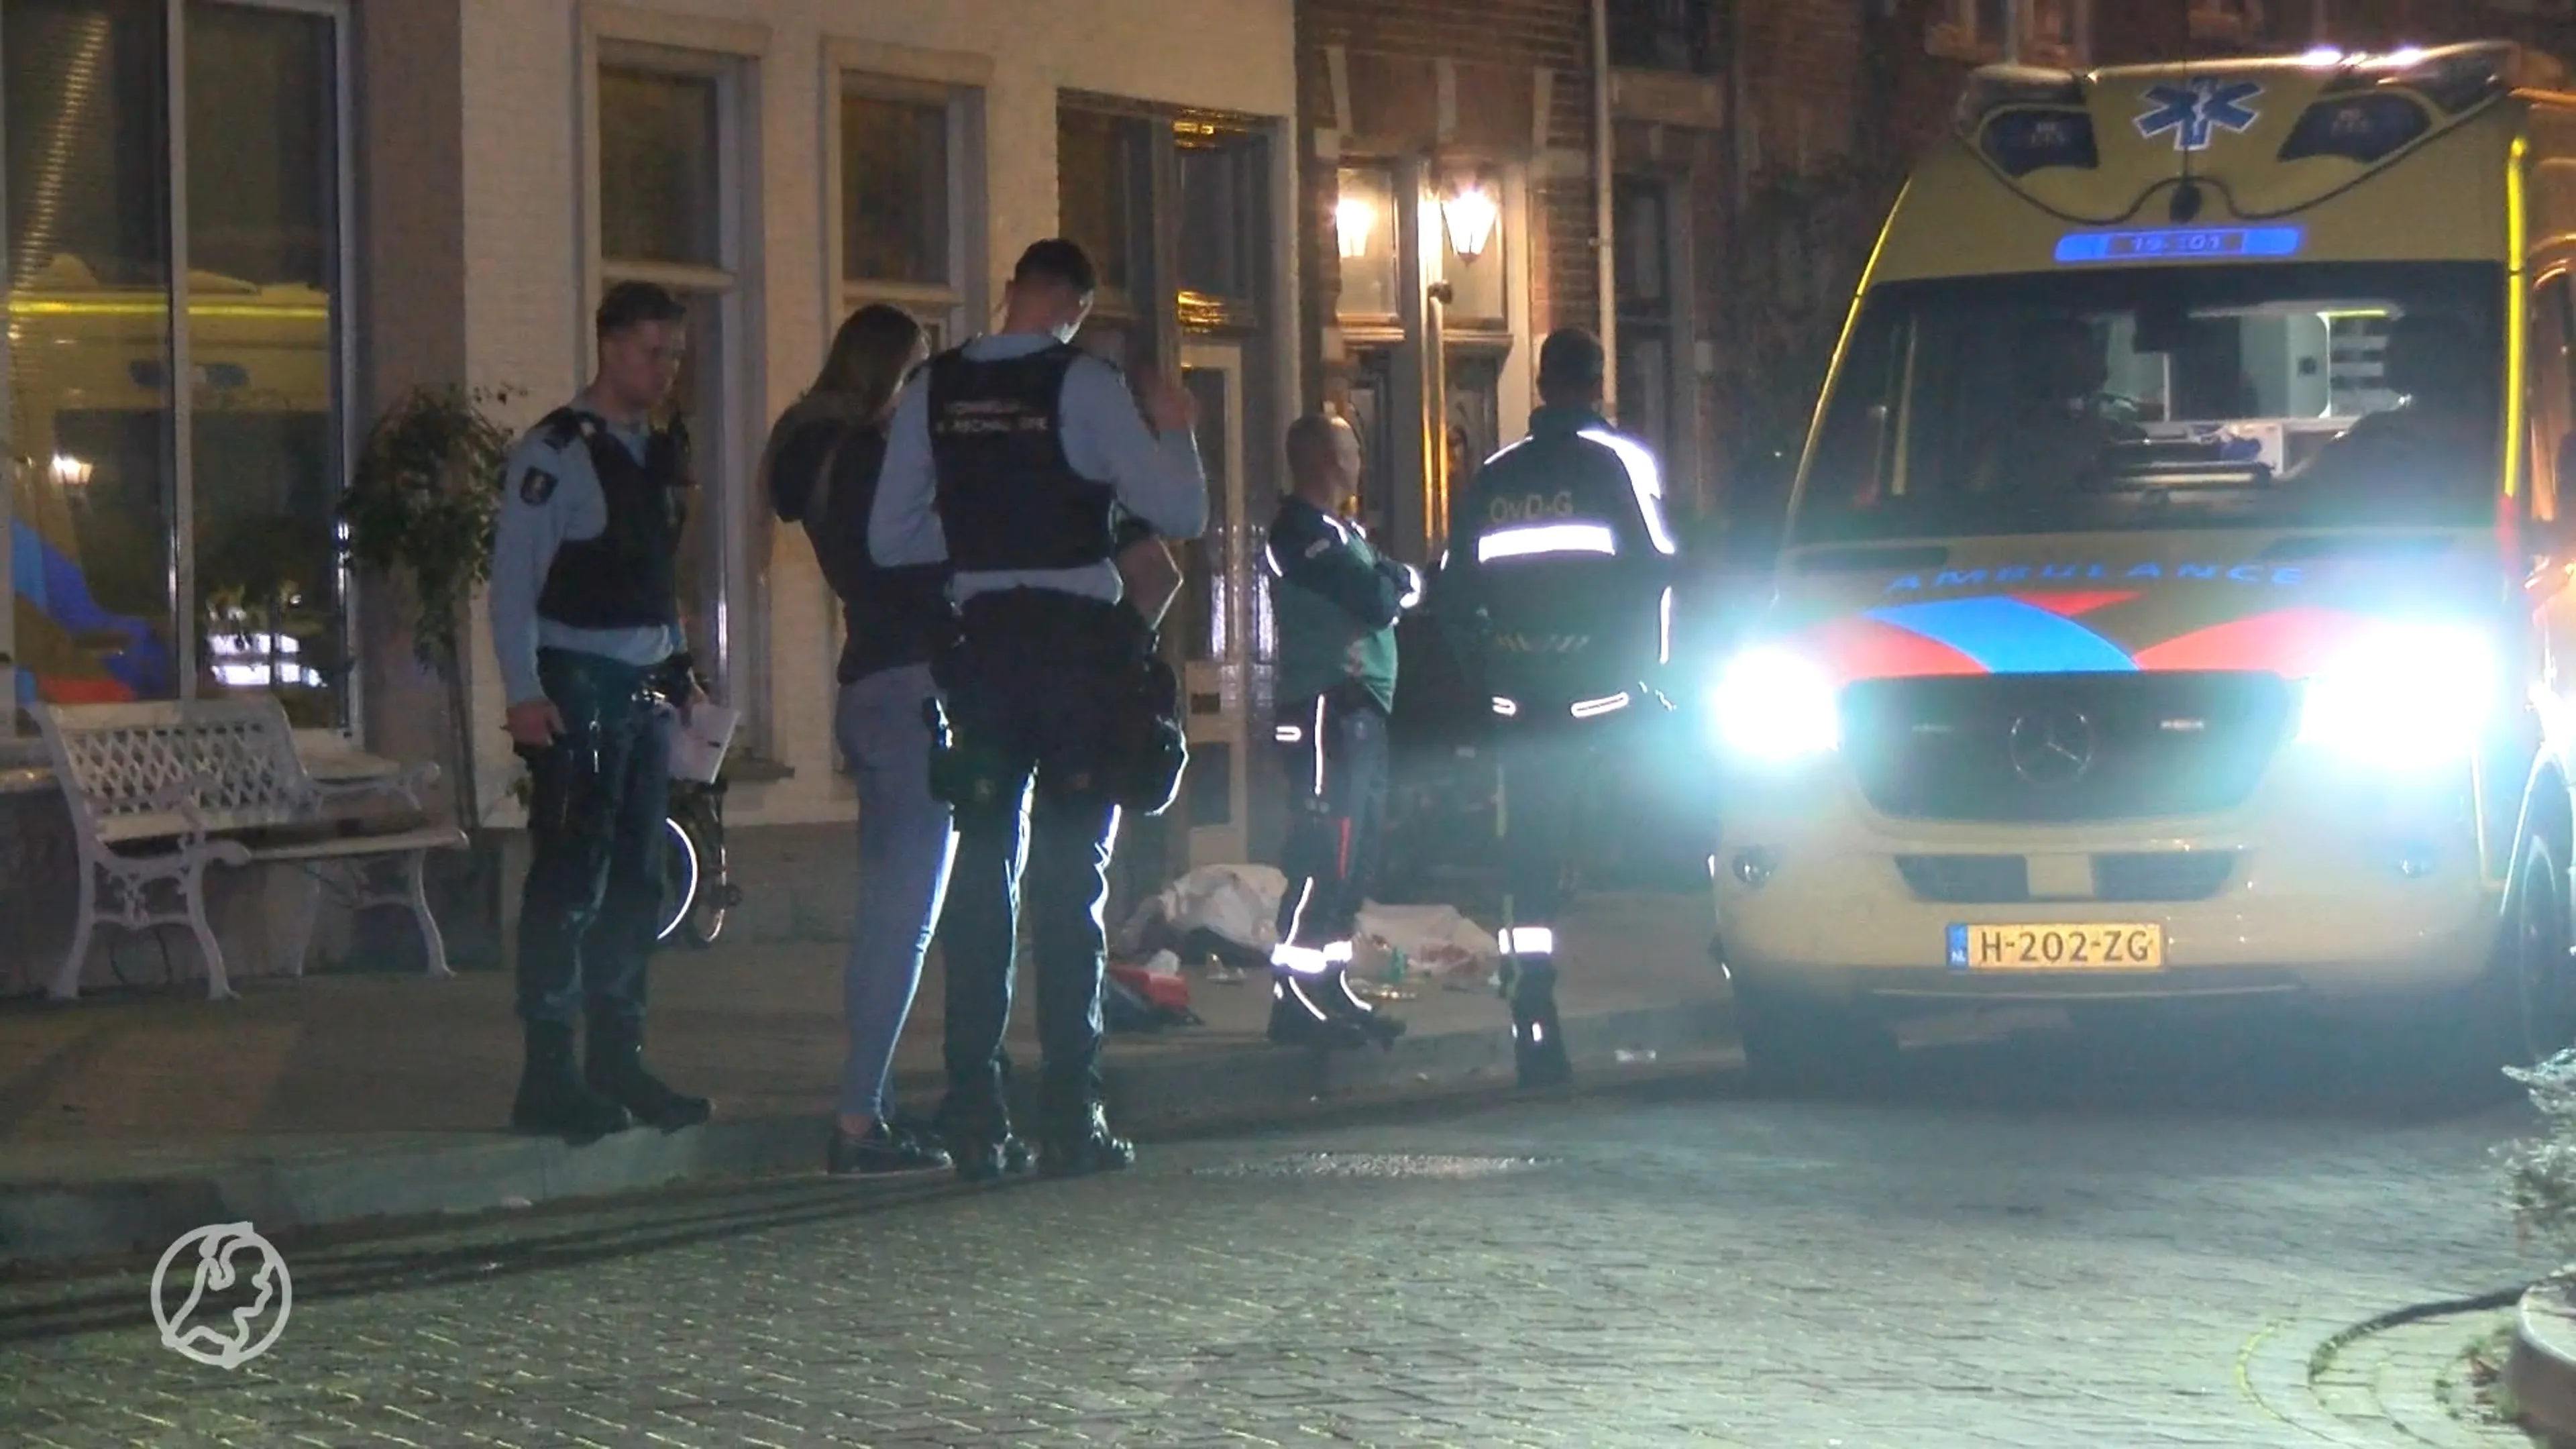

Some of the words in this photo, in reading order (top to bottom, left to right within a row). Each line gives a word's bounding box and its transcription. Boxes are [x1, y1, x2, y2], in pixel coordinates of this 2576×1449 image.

[1490, 490, 1574, 525] OvD-G
[1886, 562, 2302, 592] AMBULANCE
[1981, 930, 2149, 964] H-202-ZG
